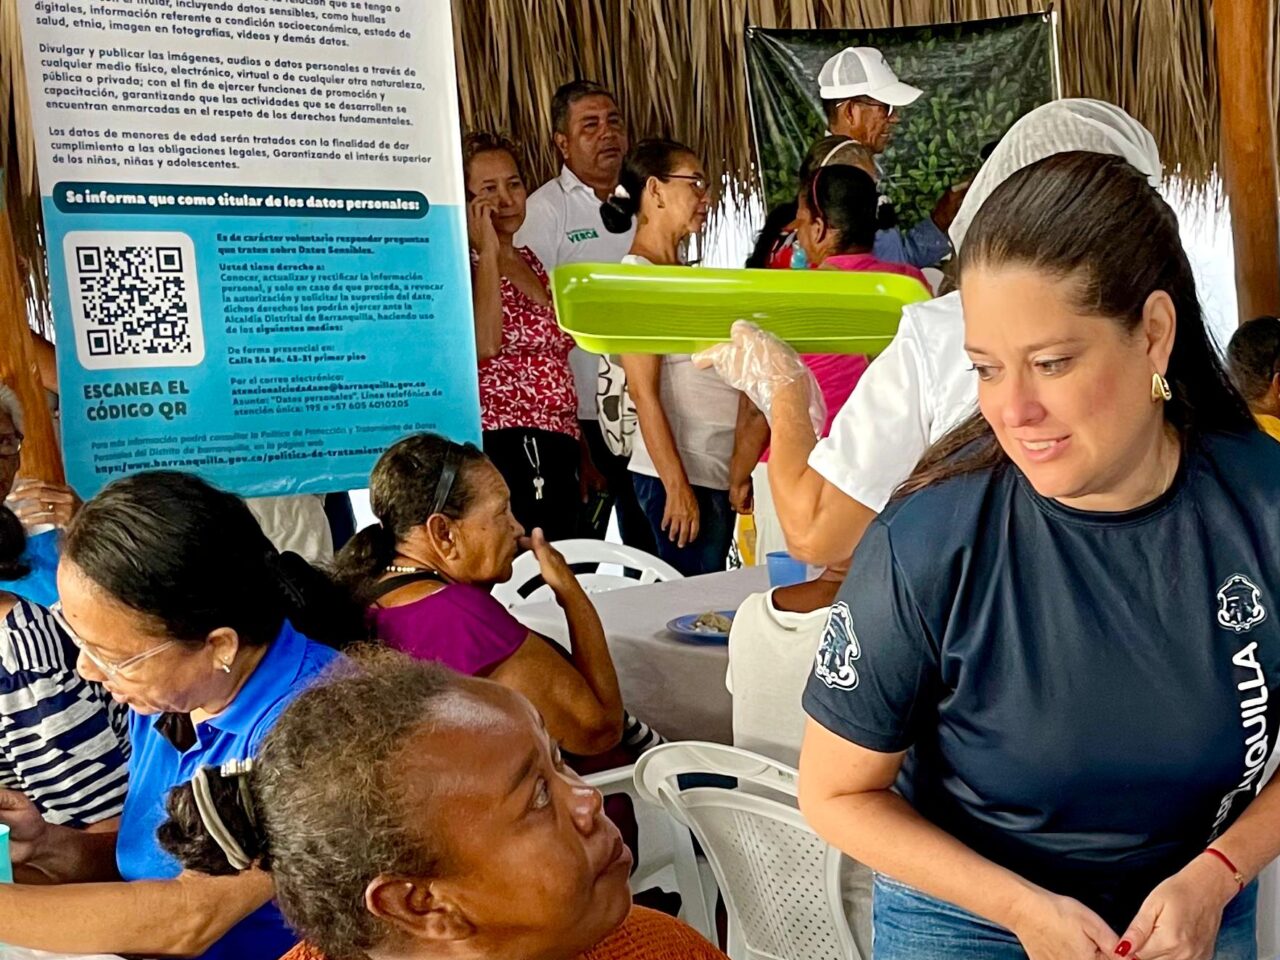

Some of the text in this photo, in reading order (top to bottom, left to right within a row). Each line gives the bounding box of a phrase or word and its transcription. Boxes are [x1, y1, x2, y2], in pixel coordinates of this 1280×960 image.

[175, 0, 233, 11] incluyendo
[236, 2, 266, 14] datos
[269, 7, 318, 20] sensibles,
[321, 12, 348, 21] como
[351, 12, 386, 24] huellas
[328, 0, 347, 9] que
[350, 1, 361, 9] se
[363, 1, 392, 14] tenga
[34, 0, 86, 15] digitales,
[89, 4, 157, 19] información
[161, 10, 211, 23] referente
[214, 16, 221, 24] a
[224, 16, 275, 28] condición
[278, 20, 361, 36] socioeconómica,
[363, 28, 396, 37] estado
[398, 29, 411, 39] de
[36, 15, 69, 28] salud,
[72, 18, 105, 30] etnia,
[108, 19, 151, 34] imagen
[154, 25, 168, 33] en
[273, 34, 279, 44] y
[282, 32, 316, 44] demás
[318, 35, 349, 47] datos.
[39, 42, 85, 57] Divulgar
[88, 48, 94, 58] y
[98, 47, 144, 59] publicar
[147, 49, 164, 60] las
[226, 55, 261, 66] audios
[264, 59, 271, 67] o
[274, 58, 302, 69] datos
[305, 62, 359, 73] personales
[371, 65, 401, 75] través
[403, 67, 416, 76] de
[40, 57, 92, 70] cualquier
[96, 61, 131, 71] medio
[134, 62, 167, 75] físico,
[170, 64, 234, 79] electrónico,
[236, 68, 269, 79] virtual
[282, 71, 295, 81] de
[298, 73, 345, 86] cualquier
[347, 76, 367, 86] otra
[370, 79, 425, 91] naturaleza,
[42, 71, 385, 102] pública o privada; con el fin de ejercer funciones de promoción y
[44, 86, 118, 99] capacitación,
[121, 90, 195, 102] garantizando
[198, 95, 219, 105] que
[222, 94, 238, 104] las
[240, 95, 299, 107] actividades
[302, 100, 321, 110] que
[338, 100, 393, 112] desarrollen
[396, 105, 406, 113] se
[45, 101, 413, 126] encuentran enmarcadas en el respeto de los derechos fundamentales.
[48, 126, 409, 150] Los datos de menores de edad serán tratados con la finalidad de dar
[50, 140, 124, 152] cumplimiento
[138, 142, 154, 153] las
[158, 143, 225, 156] obligaciones
[228, 146, 269, 159] legales,
[272, 148, 341, 160] Garantizando
[344, 151, 353, 160] el
[355, 151, 389, 161] interés
[392, 154, 431, 164] superior
[52, 153, 240, 169] de los niños, niñas y adolescentes.
[66, 190, 419, 211] Se informa que como titular de los datos personales:
[83, 380, 190, 400] ESCANEA EL
[86, 401, 187, 421] CÓDIGO QR
